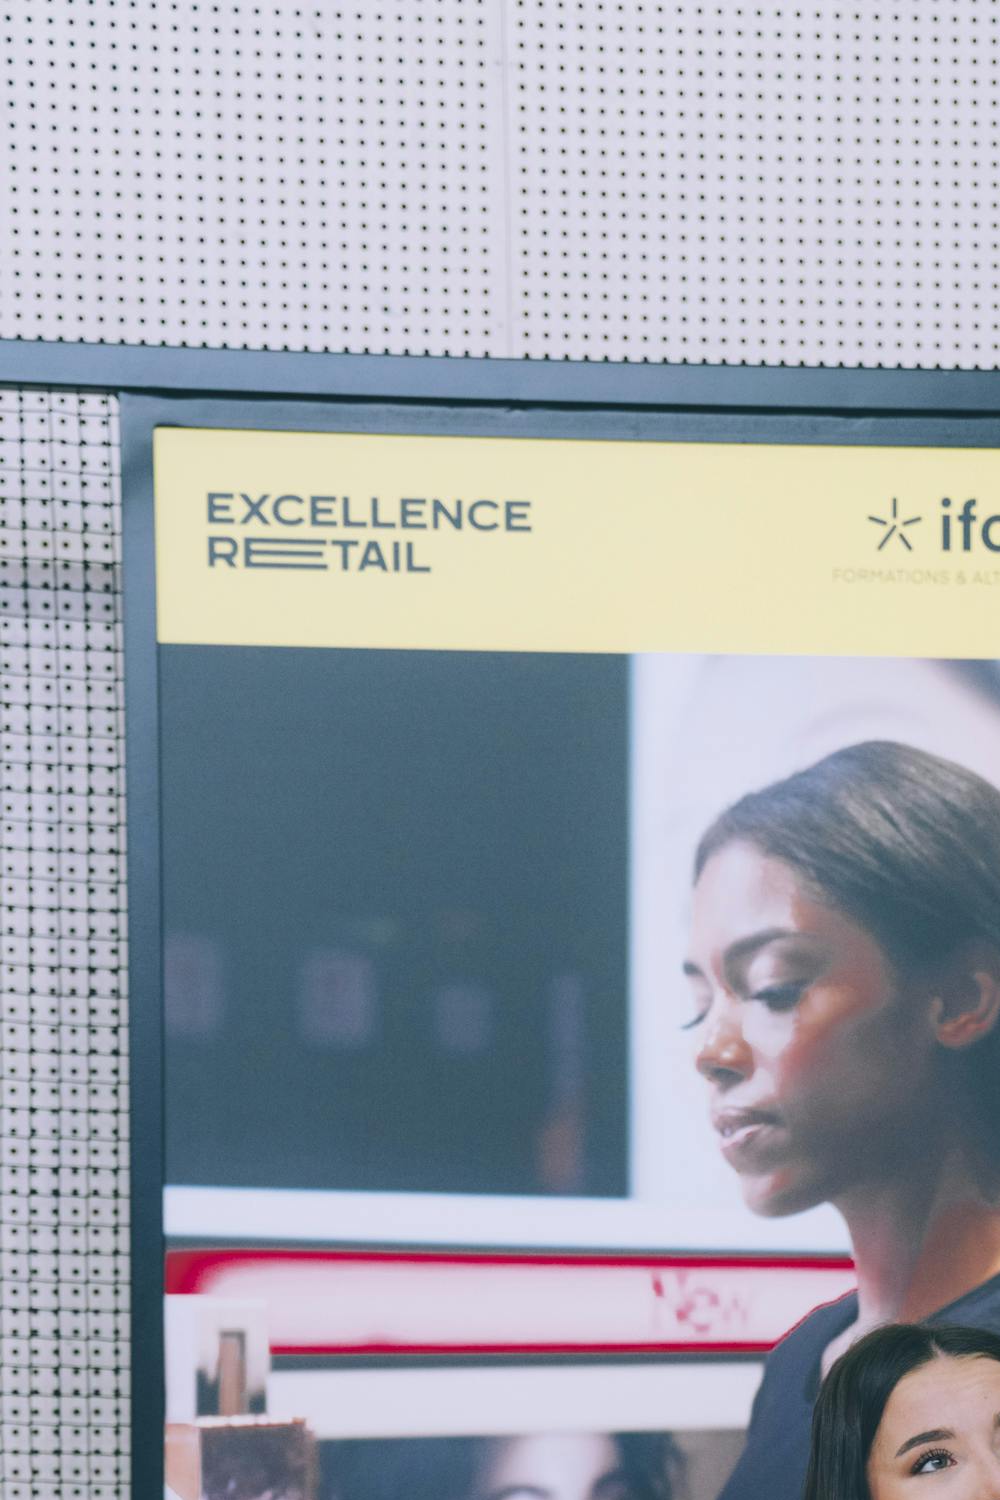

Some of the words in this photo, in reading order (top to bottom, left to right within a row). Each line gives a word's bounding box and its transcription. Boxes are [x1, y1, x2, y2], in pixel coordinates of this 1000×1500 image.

[206, 491, 533, 533] EXCELLENCE
[207, 535, 432, 573] RETAIL
[832, 567, 951, 585] FORMATIONS
[955, 569, 969, 585] &
